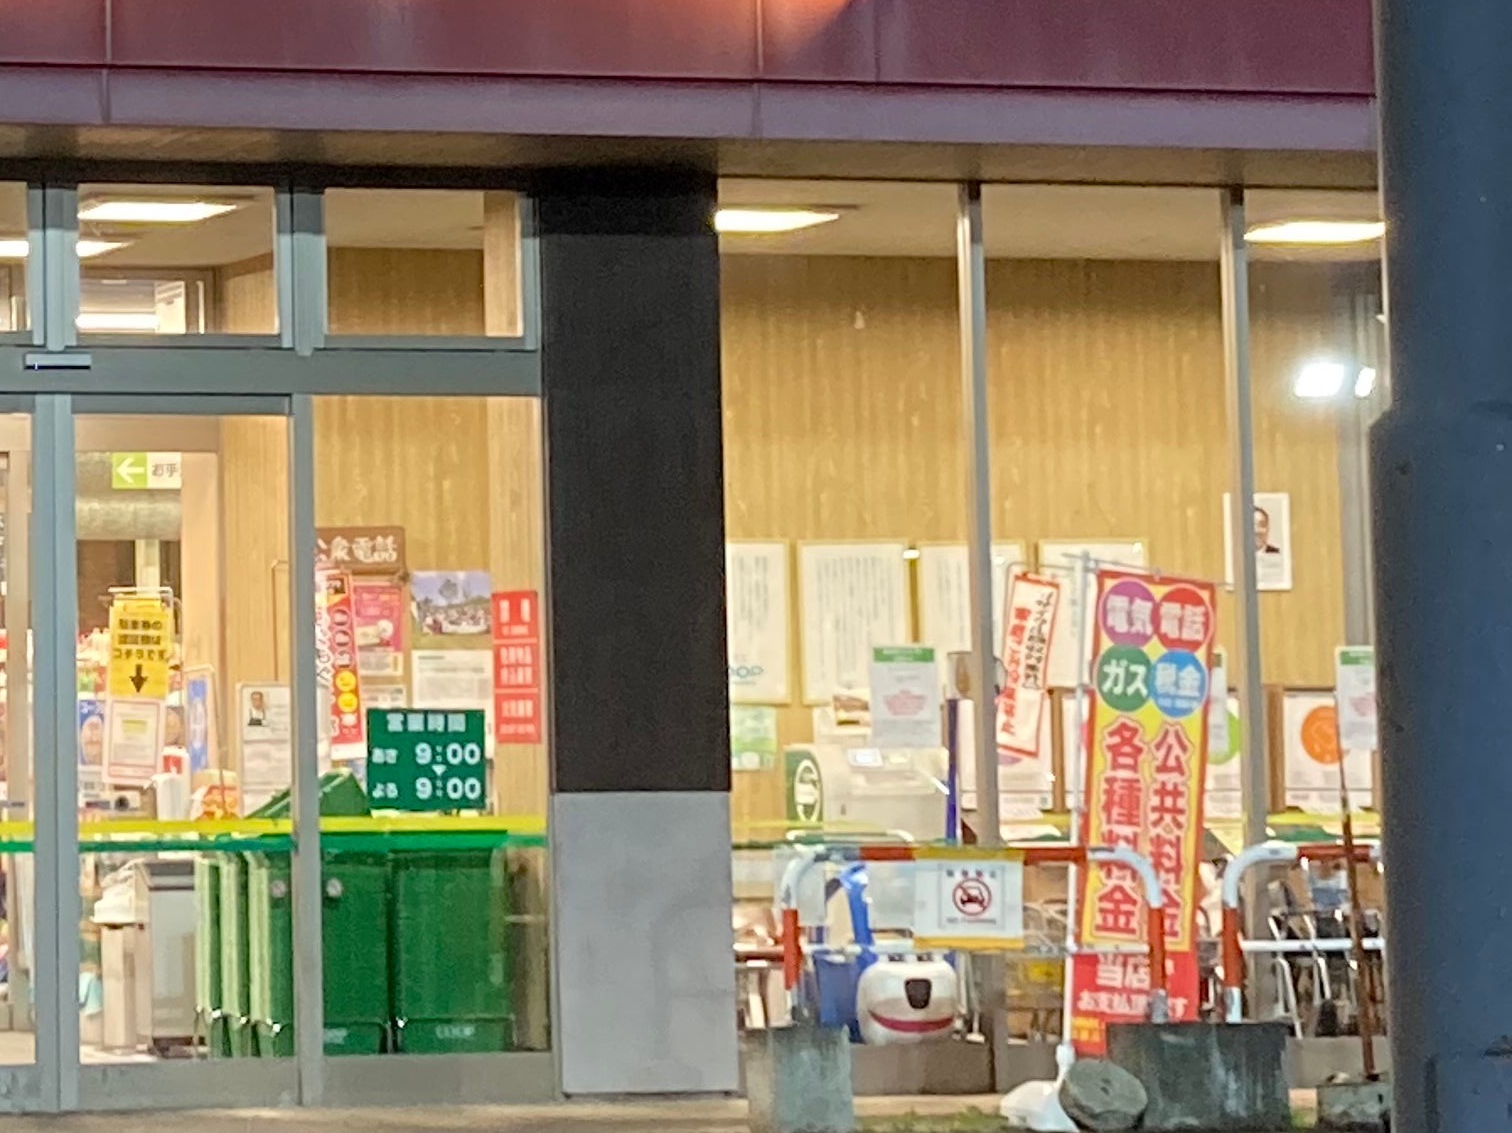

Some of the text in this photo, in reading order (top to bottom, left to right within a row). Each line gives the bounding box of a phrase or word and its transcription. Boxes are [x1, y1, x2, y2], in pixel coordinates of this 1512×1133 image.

[1101, 658, 1149, 699] ガス
[414, 742, 481, 765] 9:00
[414, 776, 482, 800] 9:00
